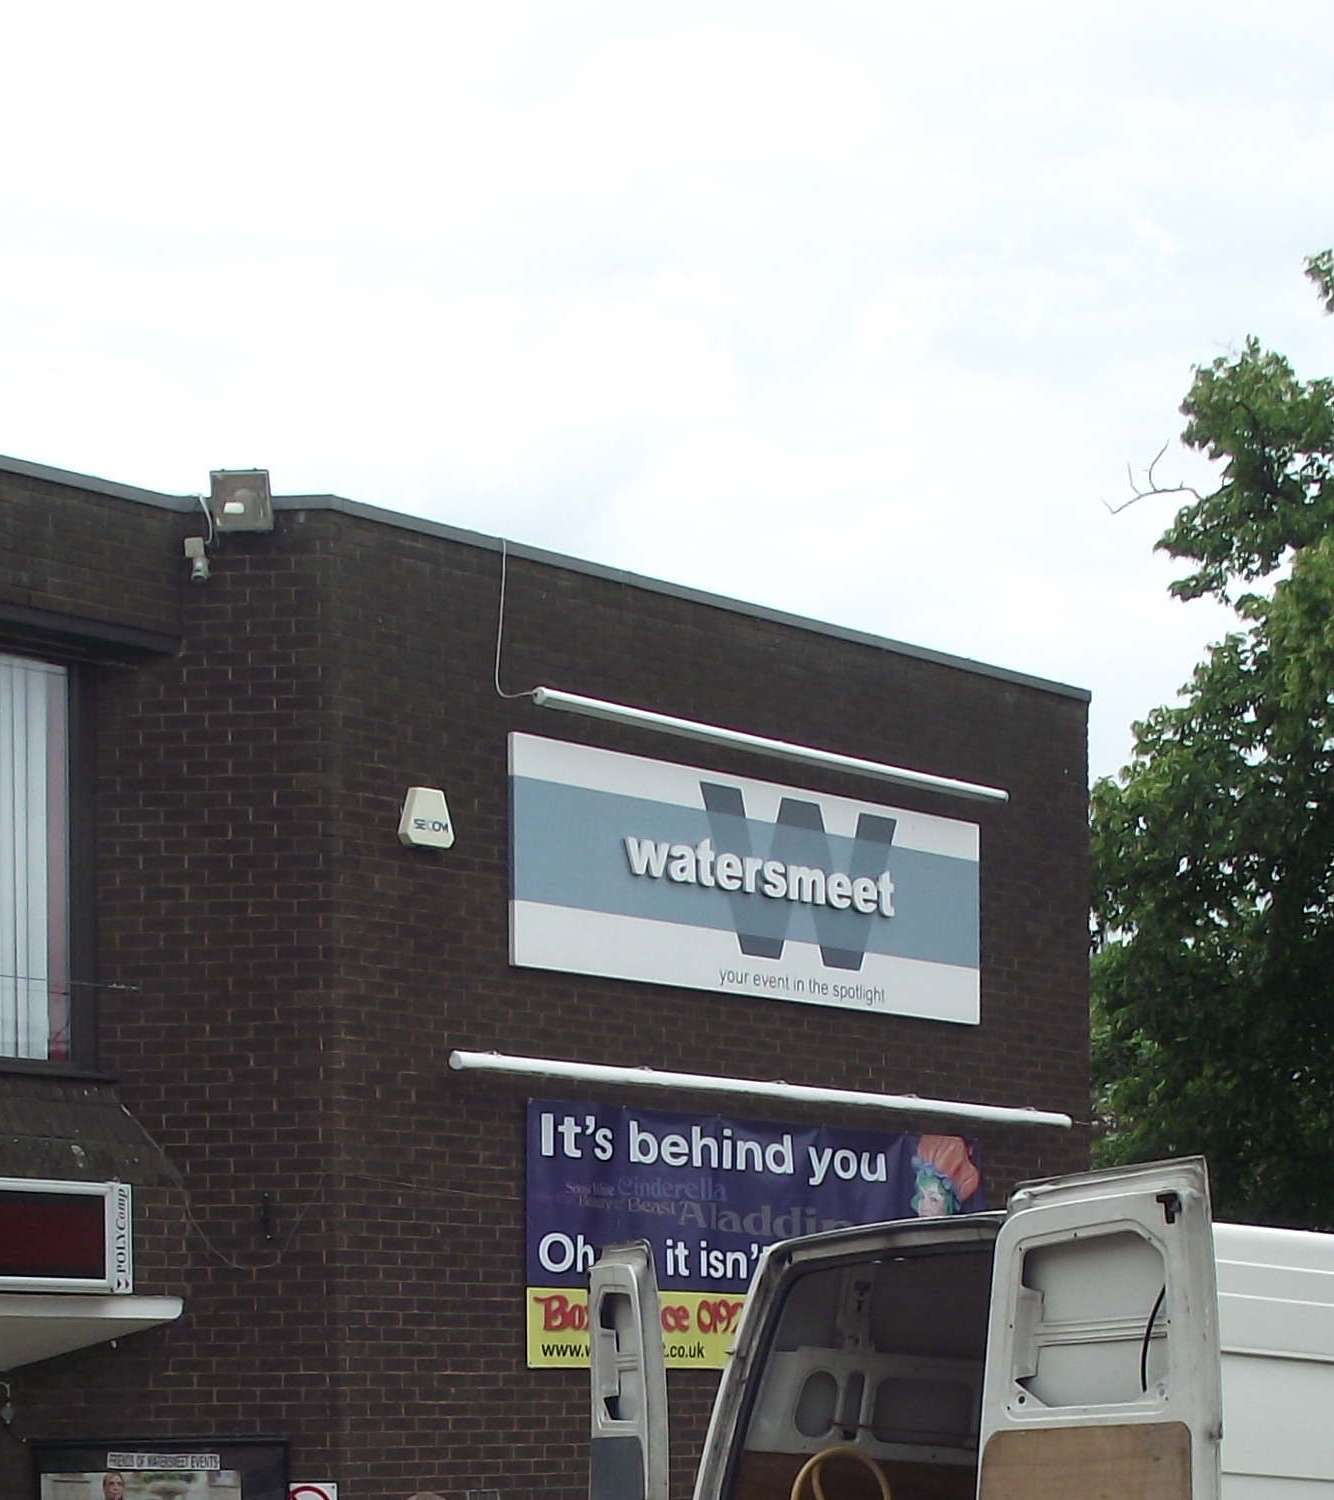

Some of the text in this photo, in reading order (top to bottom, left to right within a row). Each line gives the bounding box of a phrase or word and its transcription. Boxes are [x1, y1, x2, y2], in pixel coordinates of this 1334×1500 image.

[413, 818, 449, 833] SECOM
[624, 835, 896, 918] watersmeet
[718, 968, 885, 1006] your event in the spotlight
[540, 1112, 887, 1186] It's behind you
[617, 1175, 727, 1202] Cinderella
[539, 1232, 595, 1273] Oh
[666, 1238, 690, 1277] it
[191, 1455, 219, 1469] EVENTS
